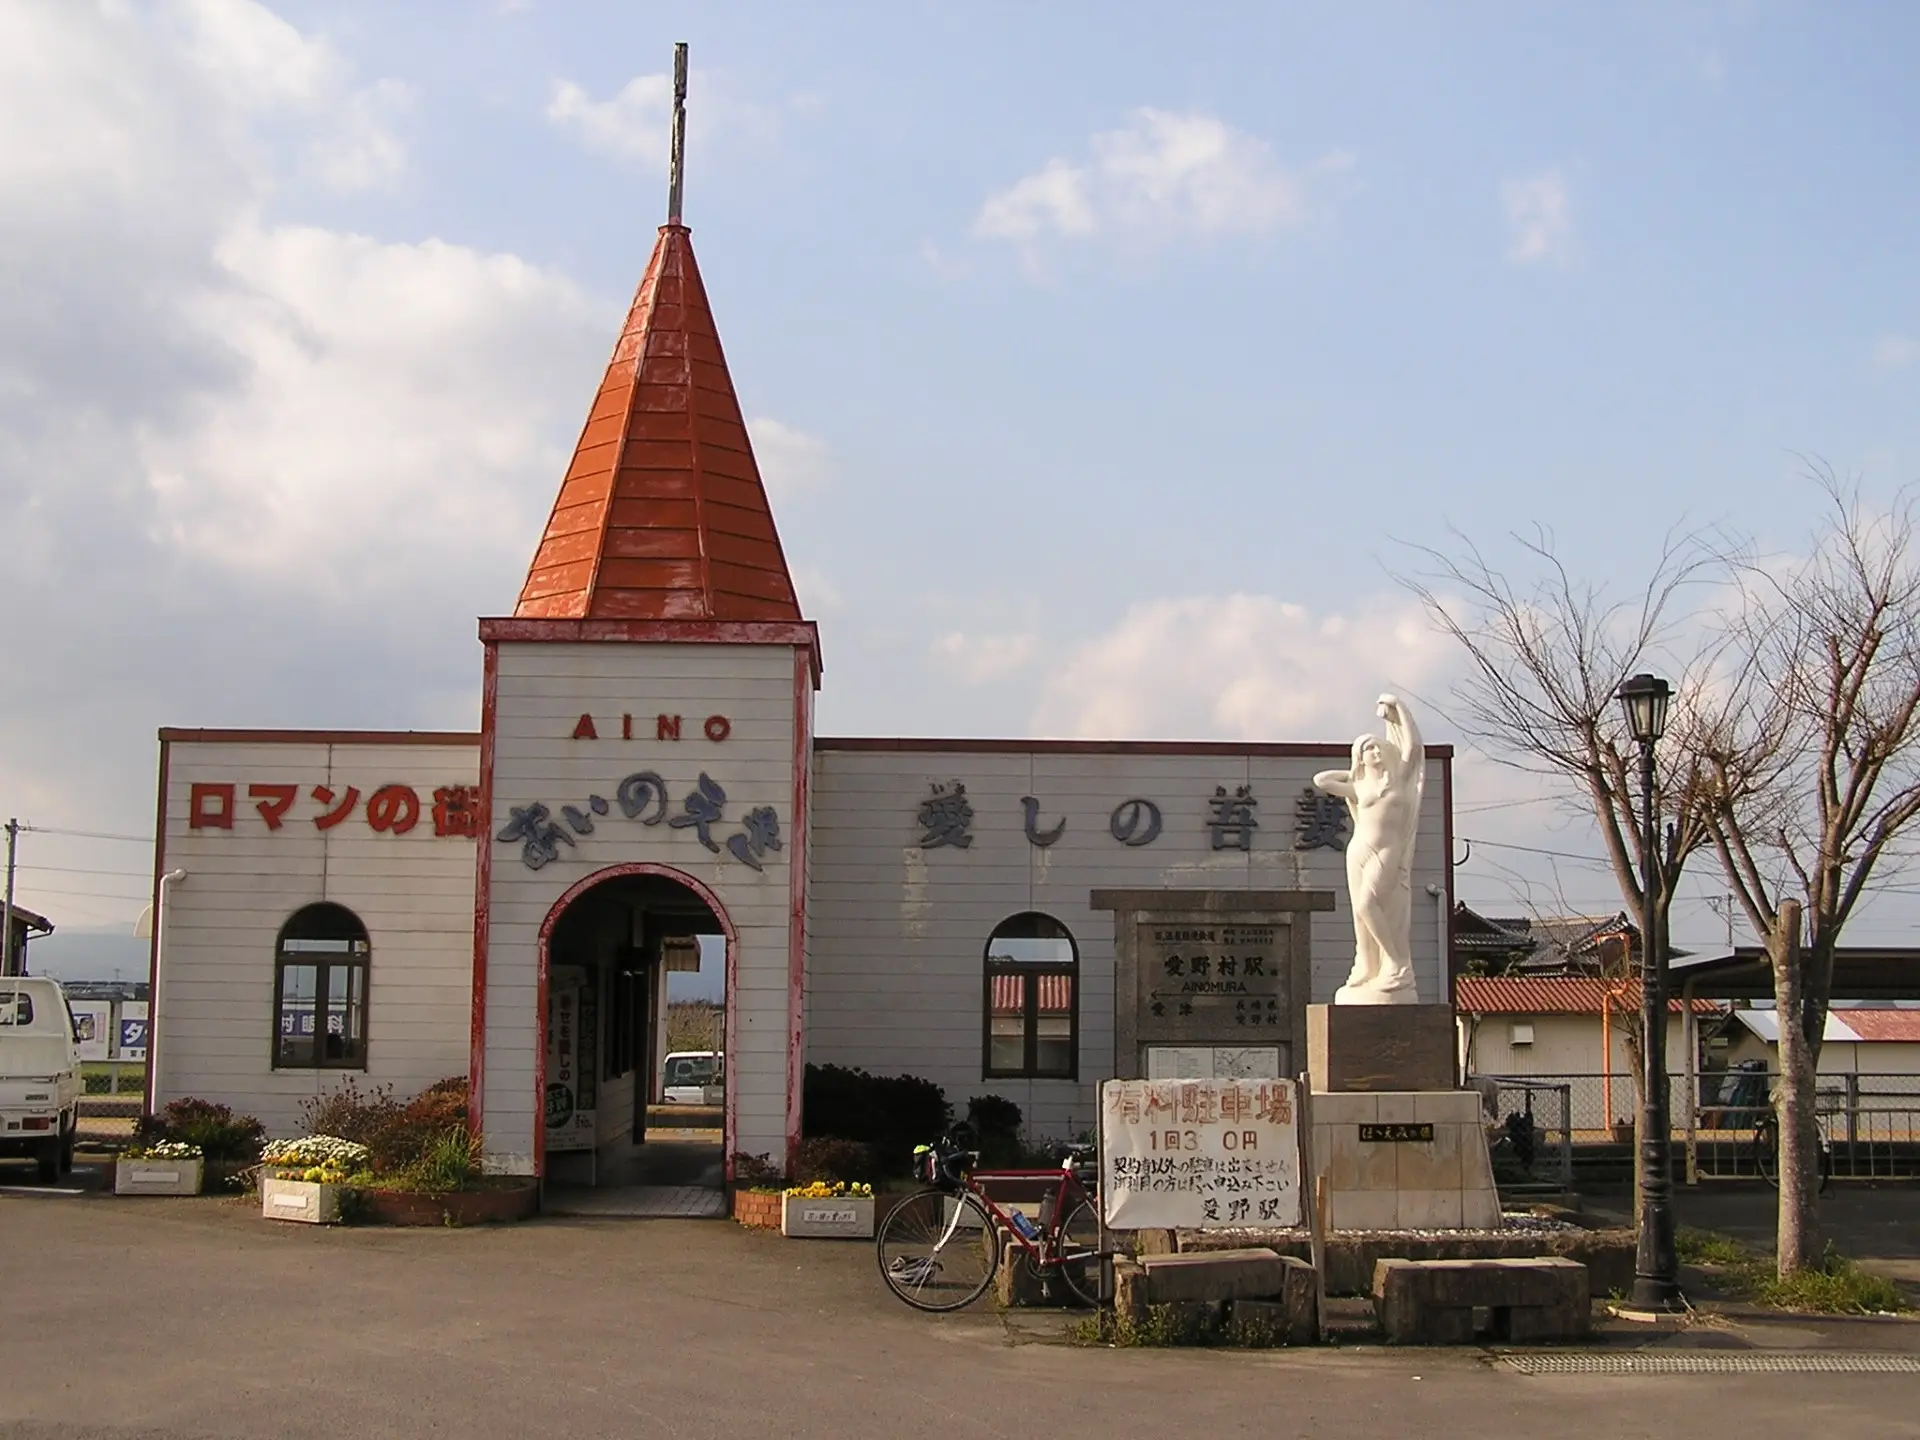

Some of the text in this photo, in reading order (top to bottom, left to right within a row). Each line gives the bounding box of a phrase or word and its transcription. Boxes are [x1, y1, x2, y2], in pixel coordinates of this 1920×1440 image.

[572, 712, 731, 742] AINO
[917, 783, 1352, 851] 愛しの吾妻
[1182, 981, 1247, 993] AINOMURA
[124, 1022, 147, 1044] タ
[1109, 1084, 1292, 1125] 有料駐車場
[1149, 1130, 1258, 1151] 1回30円
[1202, 1198, 1283, 1221] 愛野駅
